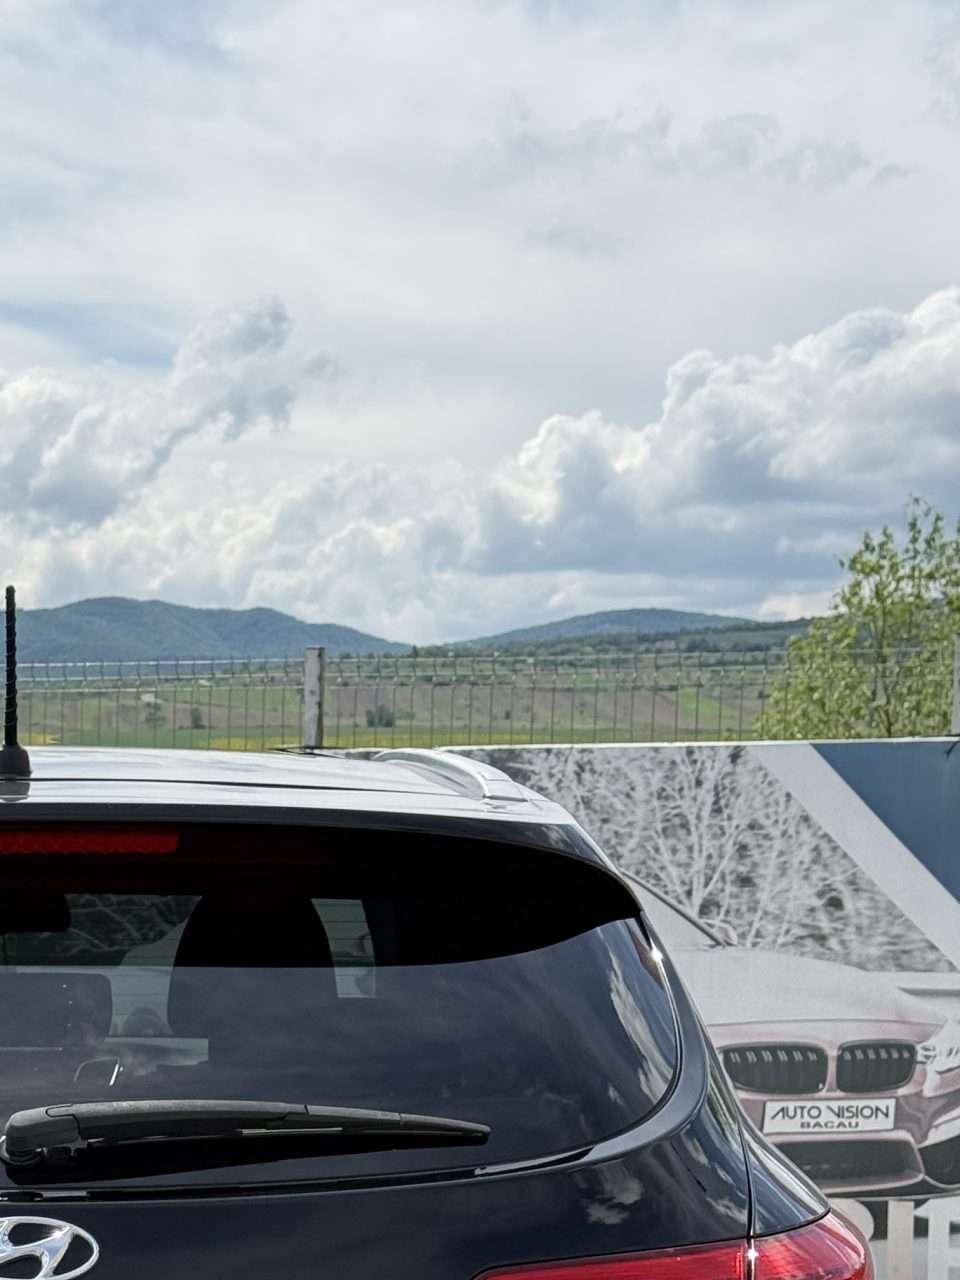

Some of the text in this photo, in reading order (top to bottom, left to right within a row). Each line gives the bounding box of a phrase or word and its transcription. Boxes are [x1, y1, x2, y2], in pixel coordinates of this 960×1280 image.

[771, 1104, 889, 1120] AUTO VISION
[800, 1121, 859, 1129] BACAU
